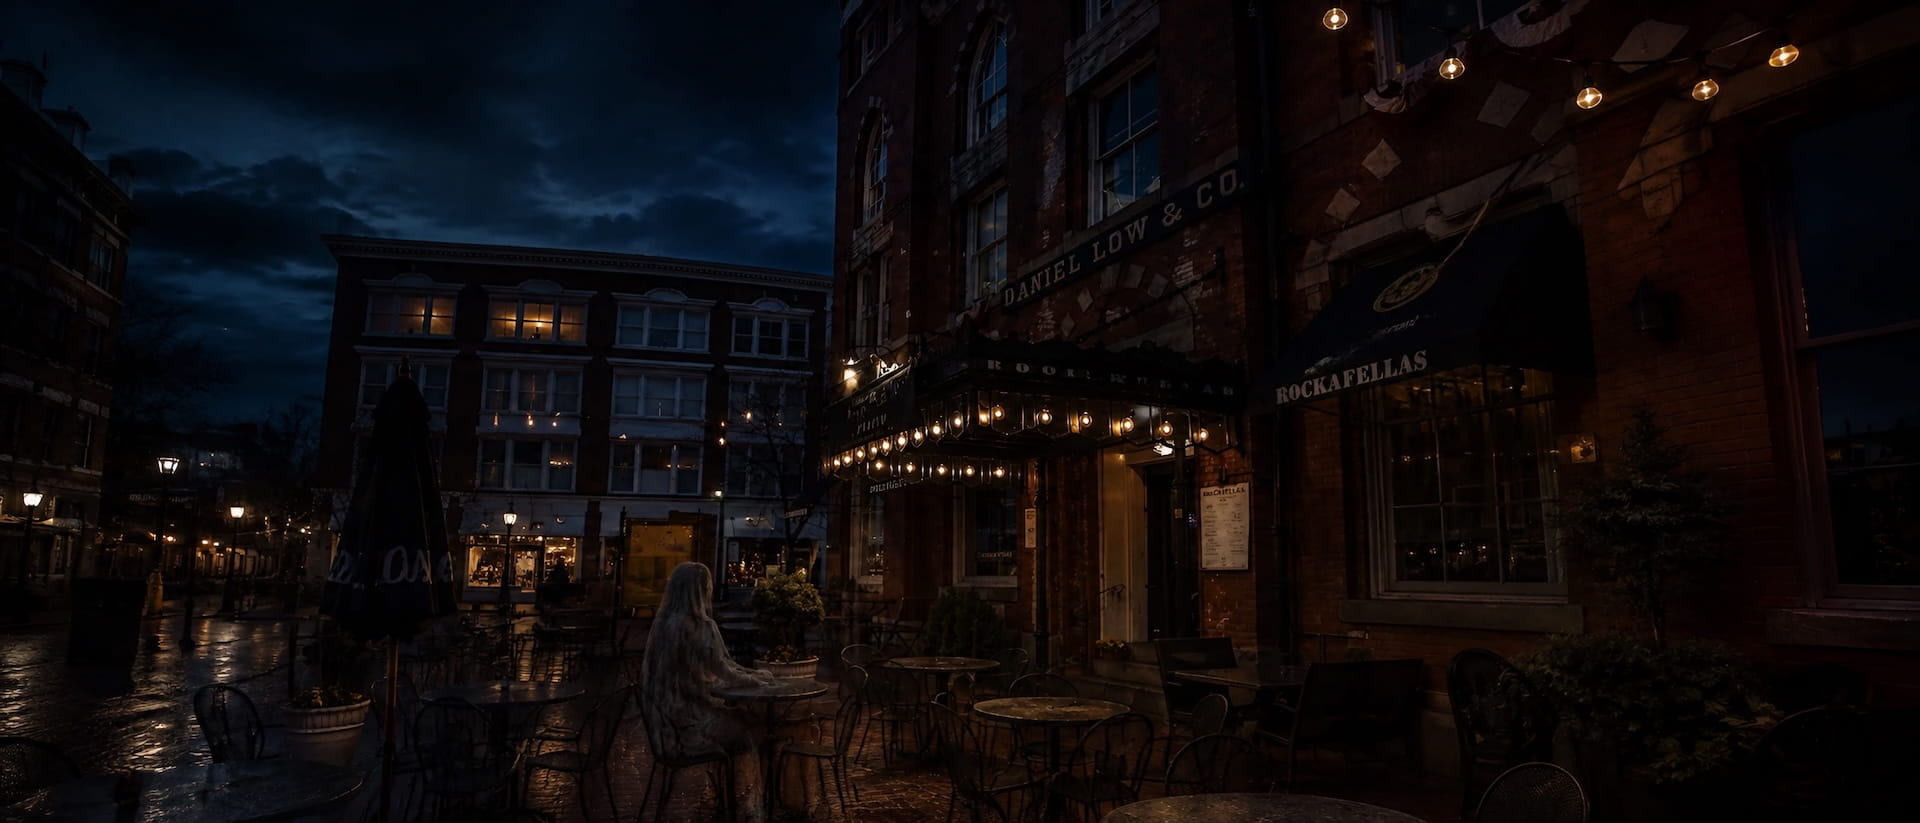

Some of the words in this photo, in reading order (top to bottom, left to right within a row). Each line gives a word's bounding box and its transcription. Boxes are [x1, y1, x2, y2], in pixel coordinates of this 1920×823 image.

[1003, 253, 1081, 307] DANIEL
[1090, 215, 1149, 264] LOW
[1161, 202, 1183, 228] &
[1195, 168, 1246, 209] CO.
[1274, 349, 1429, 406] ROCKAFELLAS
